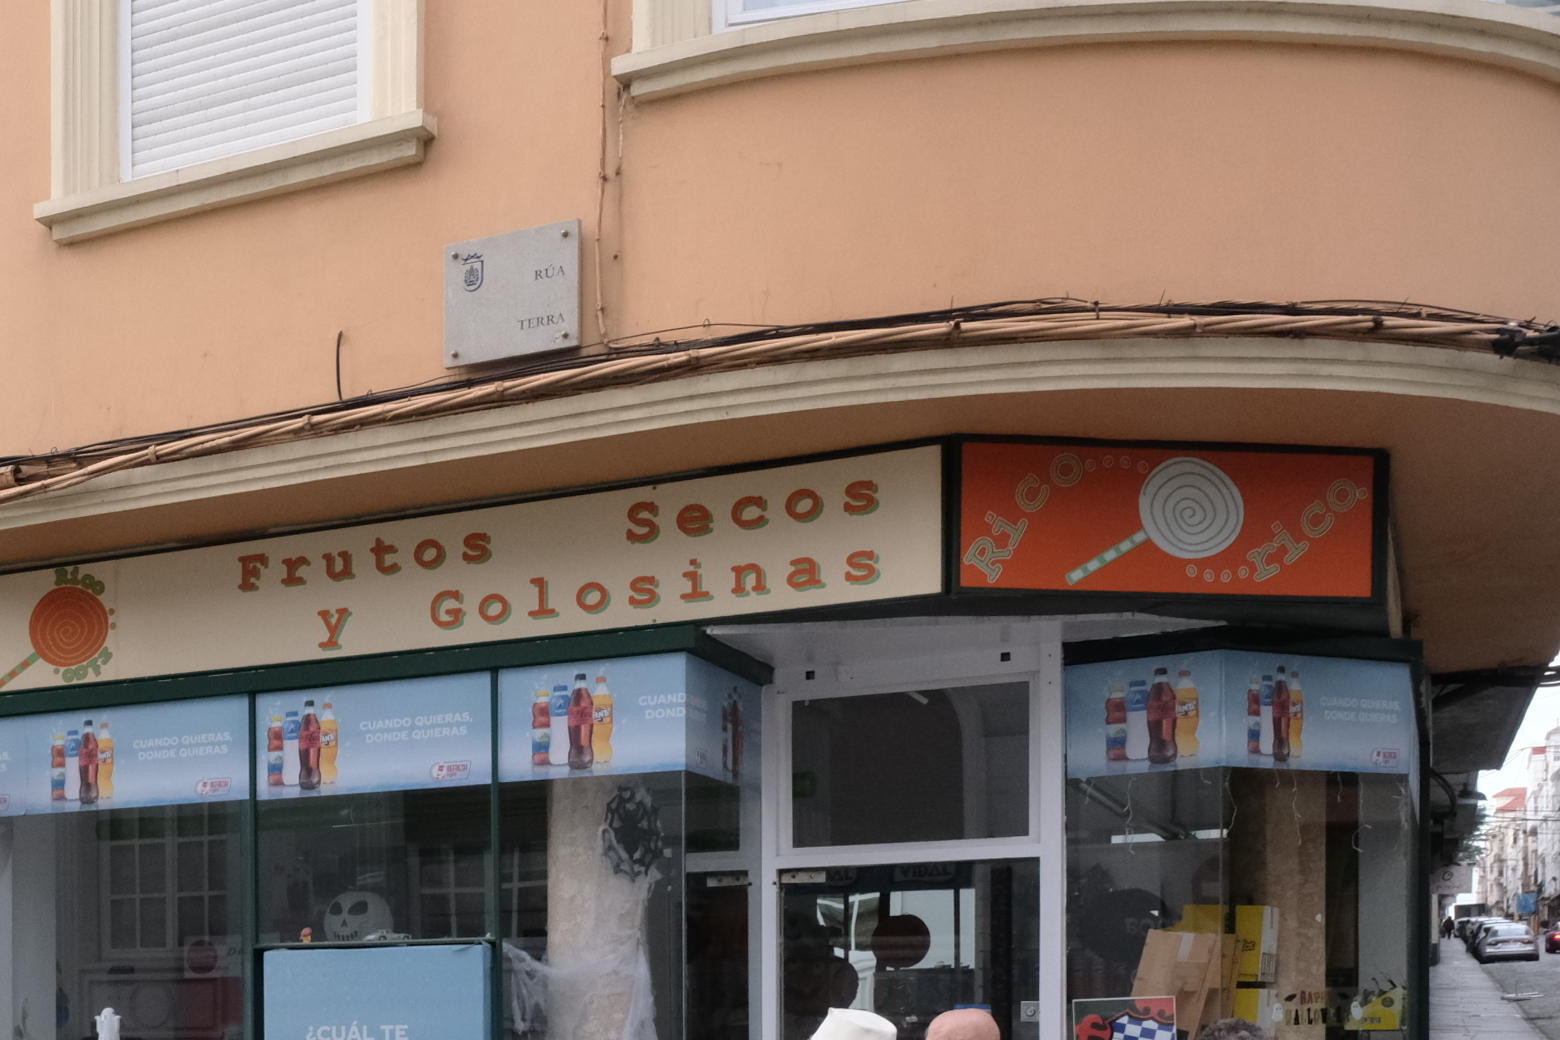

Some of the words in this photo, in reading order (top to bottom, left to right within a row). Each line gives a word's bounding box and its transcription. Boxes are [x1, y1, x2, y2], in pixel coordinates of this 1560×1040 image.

[533, 263, 566, 281] RÚA
[517, 312, 566, 331] TERRA
[237, 531, 492, 593] Frutos
[625, 479, 880, 544] Secos
[317, 607, 352, 651] y
[429, 550, 881, 630] Golosinas
[360, 717, 411, 731] CUANDO
[414, 711, 473, 727] QUIERAS,
[132, 736, 179, 750] CUANDO
[365, 730, 409, 744] DONDE
[412, 726, 468, 741] QUIERAS
[138, 749, 176, 762] DONDE
[178, 744, 229, 758] QUIERAS
